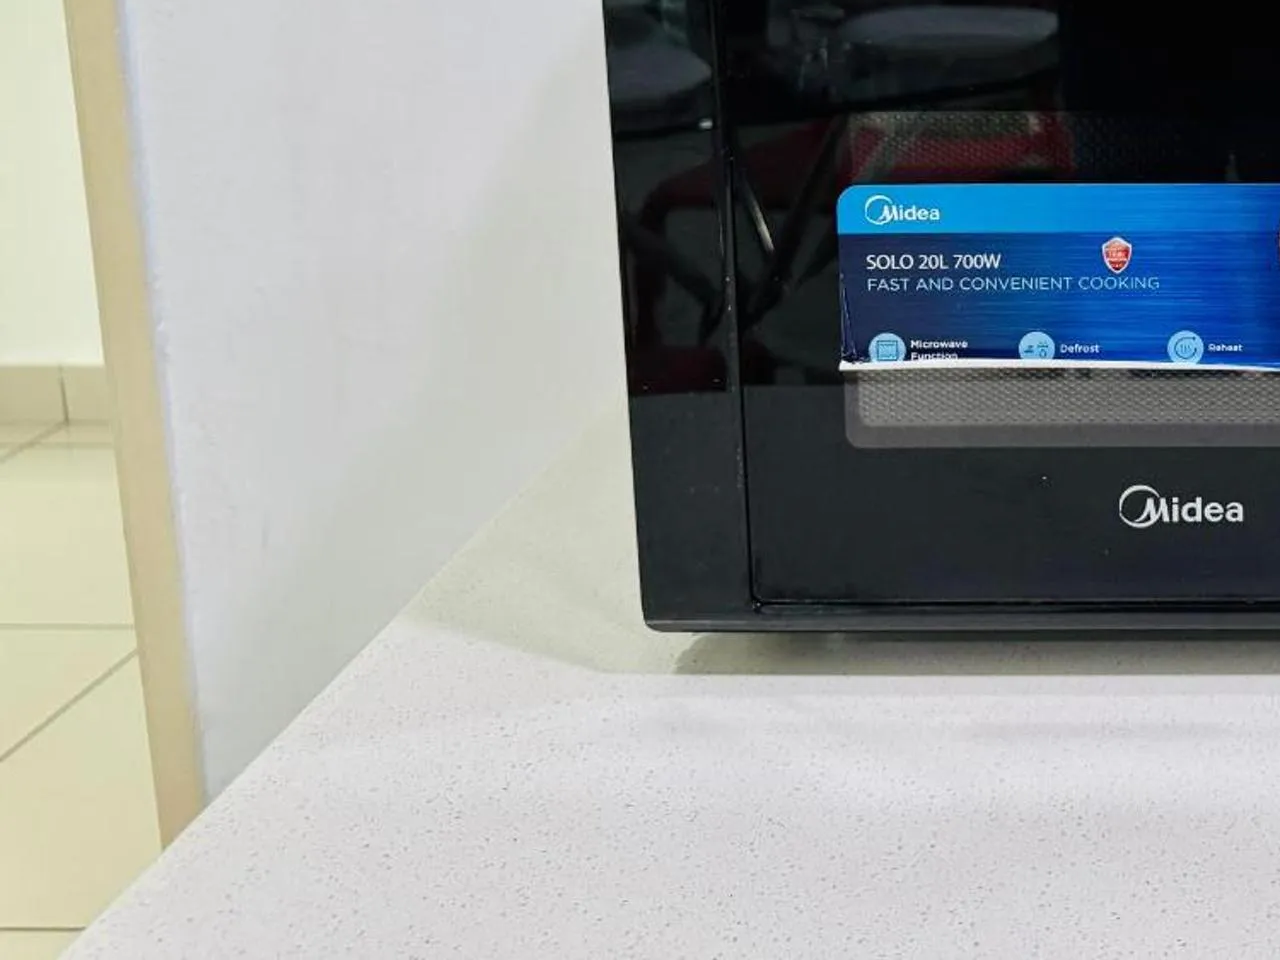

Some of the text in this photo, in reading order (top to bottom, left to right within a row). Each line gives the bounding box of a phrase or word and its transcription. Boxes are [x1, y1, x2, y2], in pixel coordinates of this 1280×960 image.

[864, 194, 940, 226] Midea
[866, 253, 1002, 271] SOLO 20L 700W
[867, 276, 1160, 292] FAST AND CONVENIENT COOKING
[910, 339, 969, 349] Microwave
[1059, 343, 1101, 354] Defrost
[910, 351, 960, 361] Function
[1120, 486, 1244, 528] Midea
